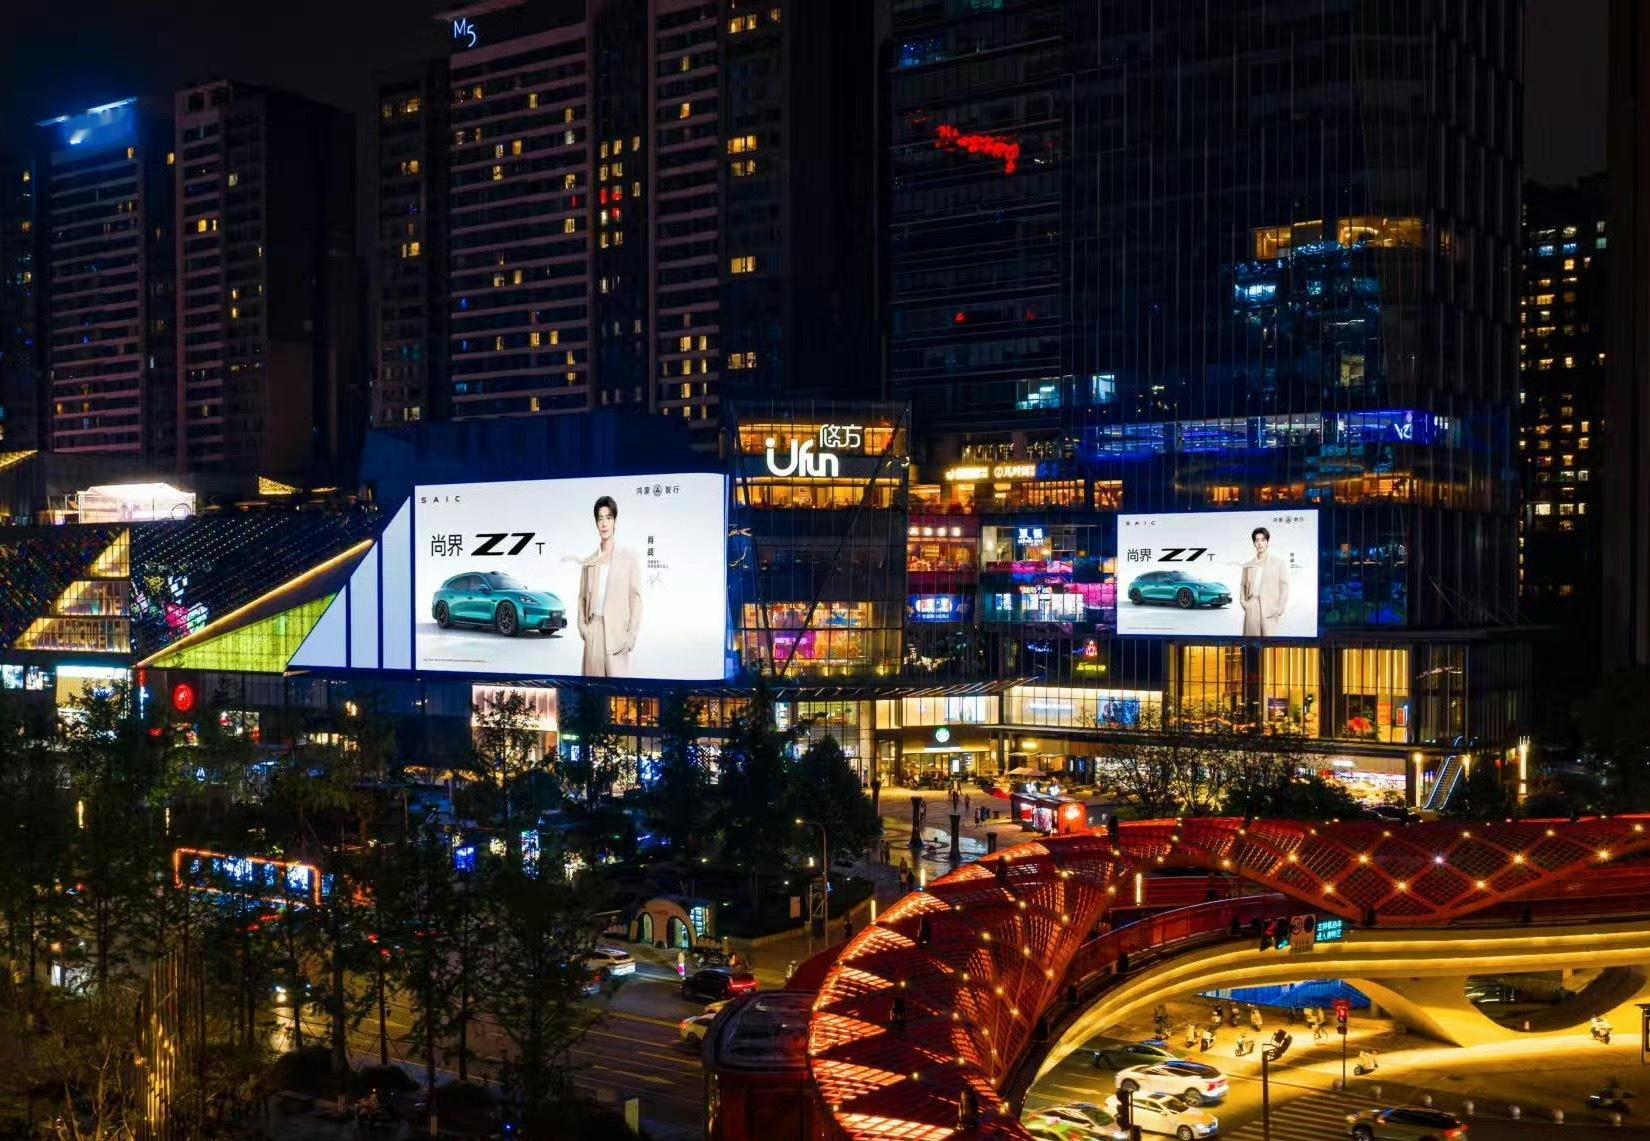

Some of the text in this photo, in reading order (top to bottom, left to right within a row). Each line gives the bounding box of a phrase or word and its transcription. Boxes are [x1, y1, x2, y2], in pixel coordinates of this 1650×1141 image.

[820, 423, 862, 448] 悠方
[420, 494, 461, 504] SAIC
[431, 534, 463, 557] 尚界
[1127, 548, 1152, 563] 尚界
